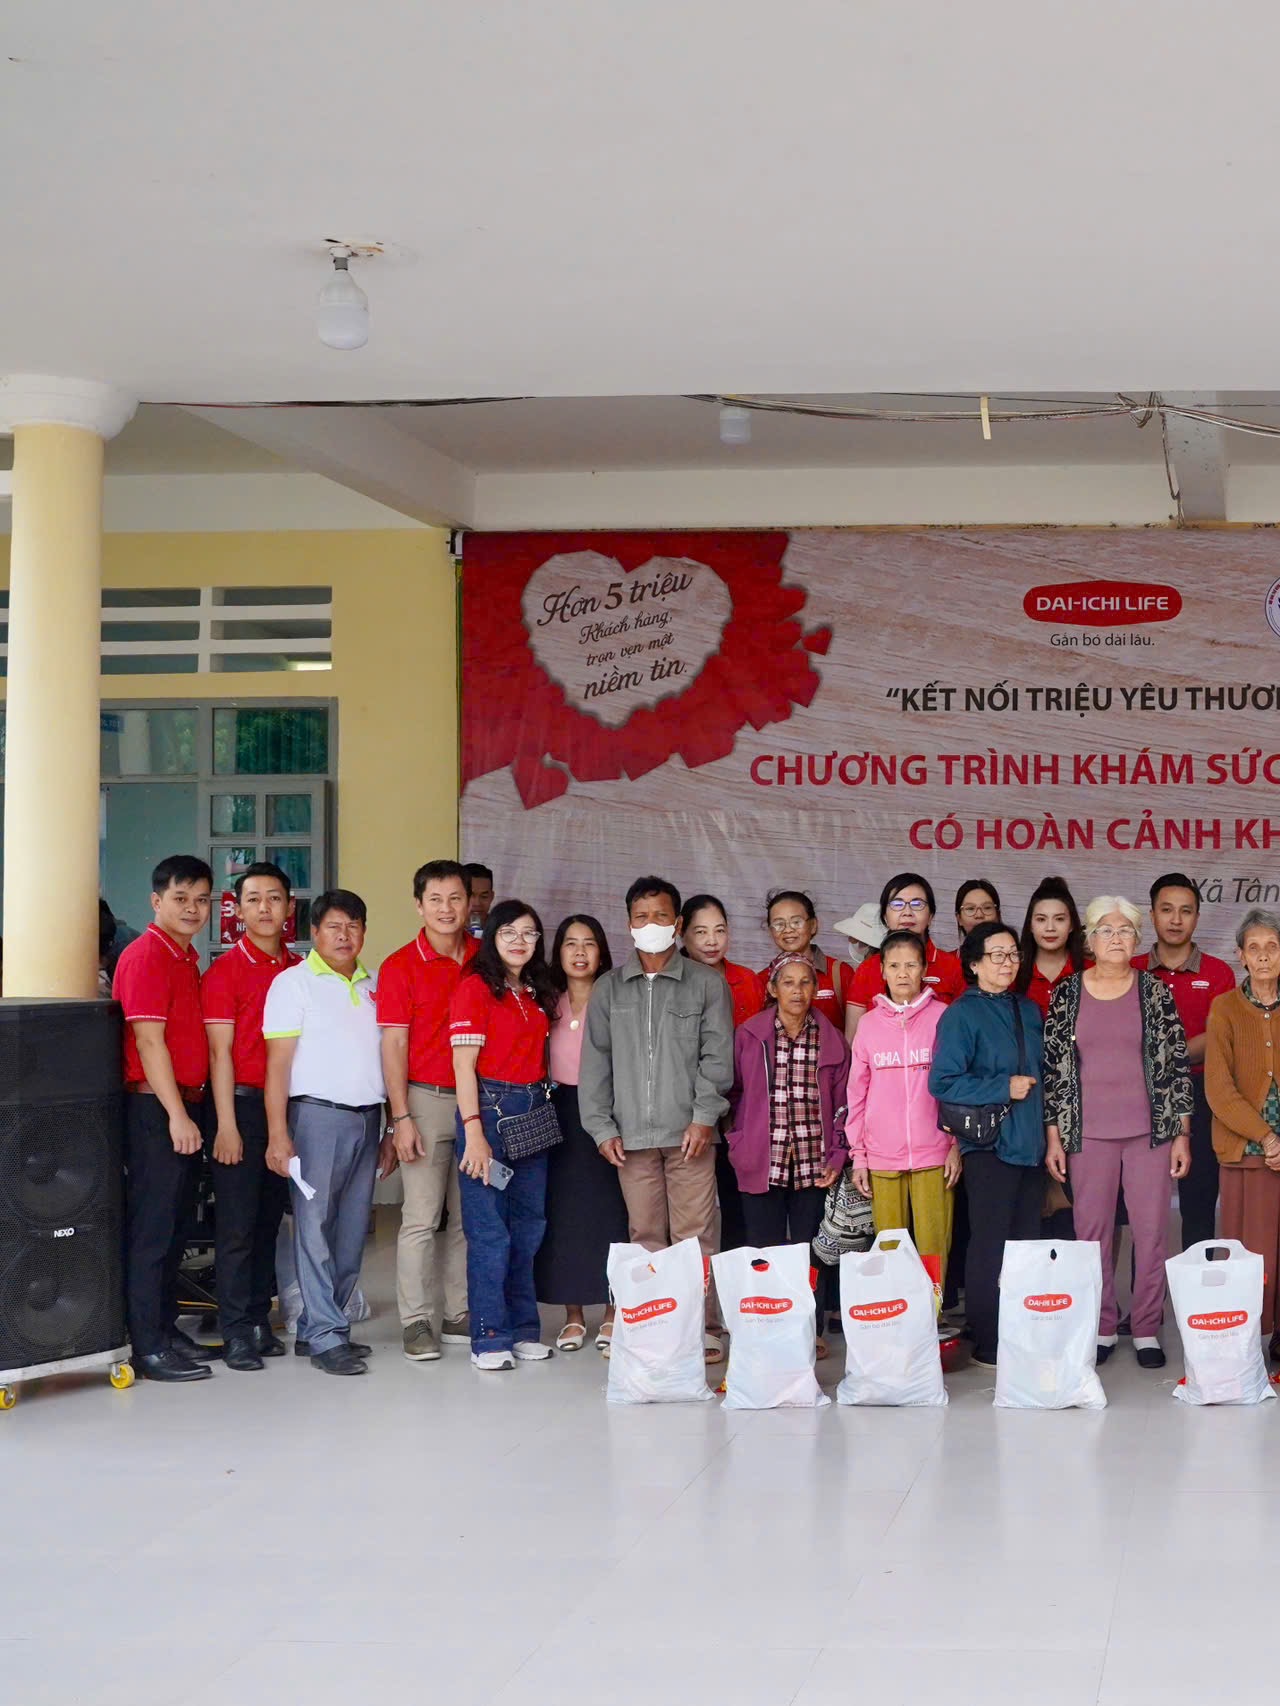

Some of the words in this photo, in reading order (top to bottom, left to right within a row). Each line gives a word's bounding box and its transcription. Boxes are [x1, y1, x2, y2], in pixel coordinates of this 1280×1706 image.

[537, 586, 601, 626] Hơn
[604, 583, 623, 610] 5
[630, 573, 693, 604] triệu
[1036, 596, 1120, 611] DAI-ICHI
[1125, 596, 1169, 611] LIFE
[579, 616, 630, 645] Khách
[1082, 632, 1101, 646] bó
[1105, 632, 1126, 646] dài
[1130, 632, 1155, 646] lâu.
[586, 651, 615, 667] trọn
[620, 643, 644, 659] vẹn
[648, 632, 674, 650] một
[584, 665, 644, 700] niềm
[965, 676, 1018, 711] NỐI
[1025, 681, 1112, 718] TRIỆU
[1121, 681, 1177, 711] YÊU
[750, 751, 927, 786] CHƯƠNG
[937, 747, 1059, 785] TRÌNH
[1074, 747, 1193, 785] KHÁM
[908, 812, 964, 850] CÓ
[976, 812, 1093, 850] HOÀN
[1106, 808, 1221, 850] CẢNH
[1233, 877, 1280, 903] Tân
[873, 1047, 933, 1067] CHANE
[53, 1227, 75, 1238] NEXO
[653, 1301, 673, 1311] LIFE
[770, 1301, 789, 1309] LIFE
[853, 1306, 887, 1316] DAI-ICHI
[888, 1302, 904, 1313] LIFE
[1192, 1316, 1226, 1325] DAI-ICHI
